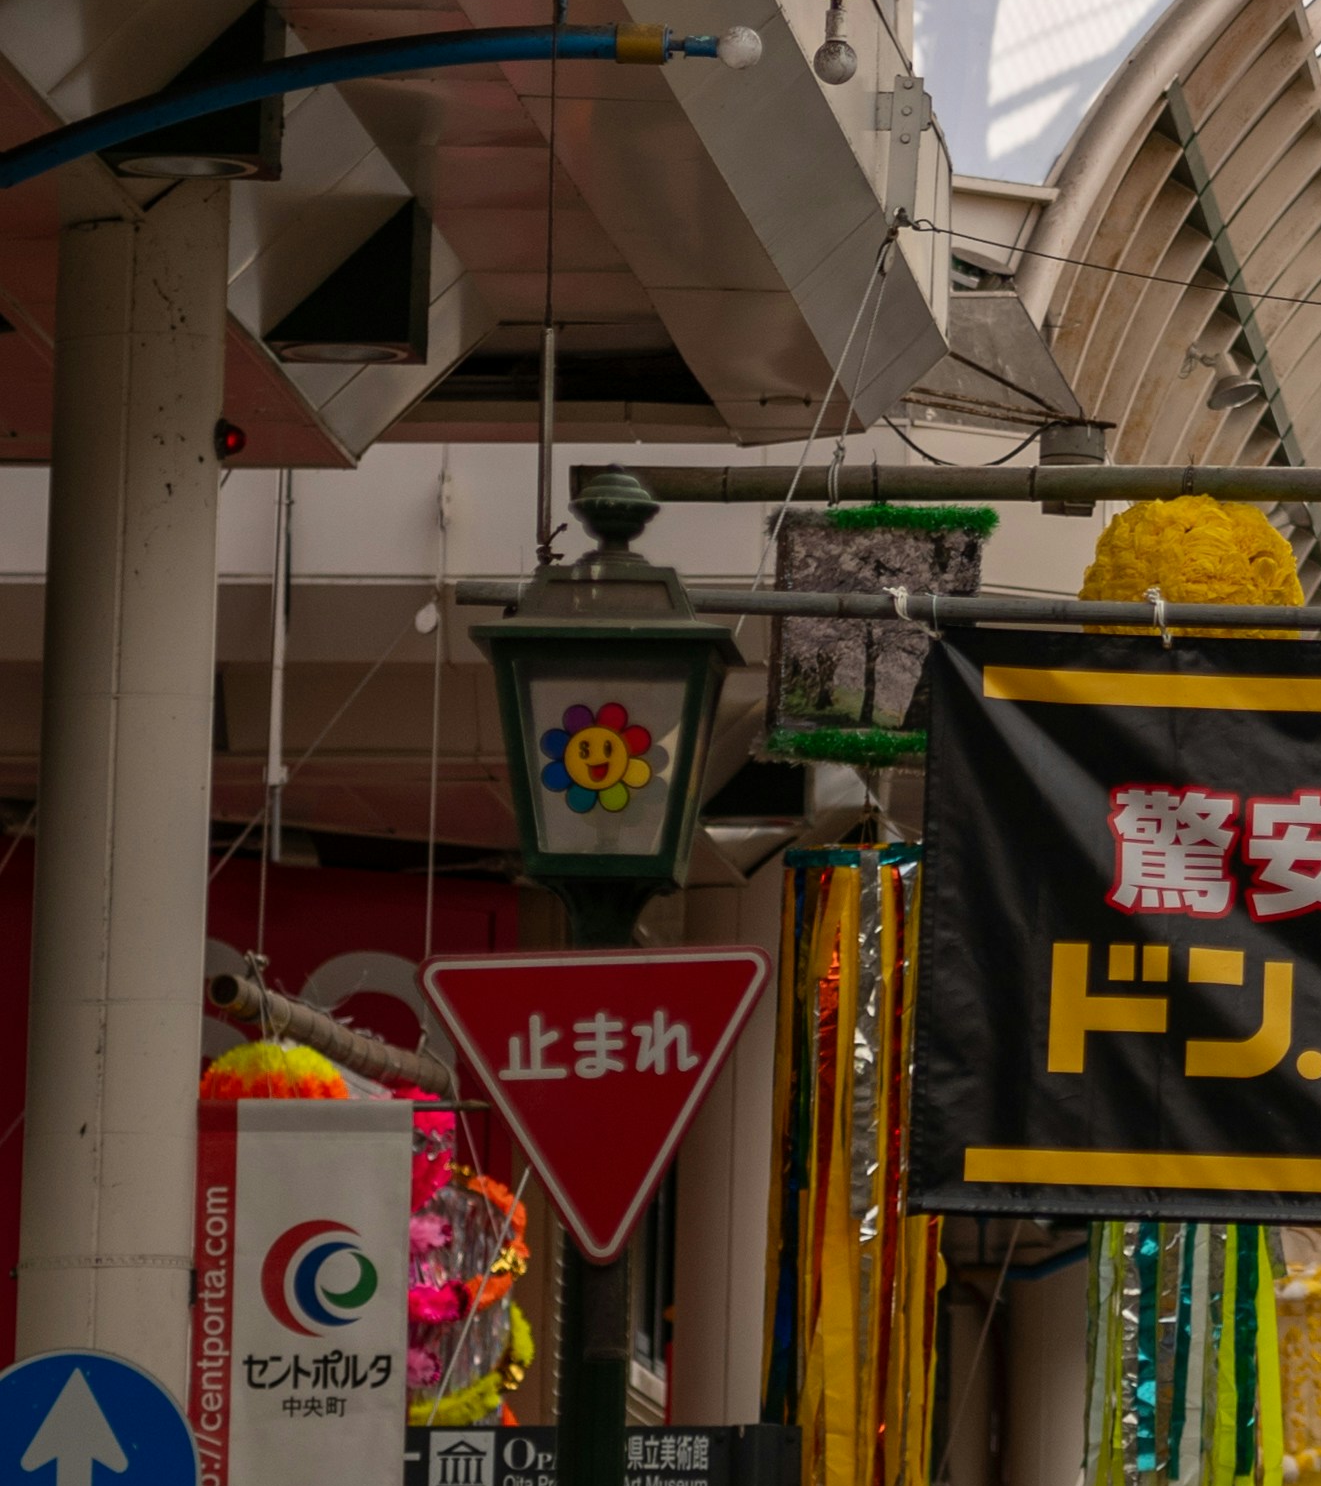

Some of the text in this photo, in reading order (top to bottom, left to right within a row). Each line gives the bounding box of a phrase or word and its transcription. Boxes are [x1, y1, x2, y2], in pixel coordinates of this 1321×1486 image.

[498, 1011, 699, 1081] 止まれ
[243, 1349, 392, 1389] セントポルタ
[282, 1396, 348, 1418] 中央町
[624, 1435, 710, 1471] 県立美術館
